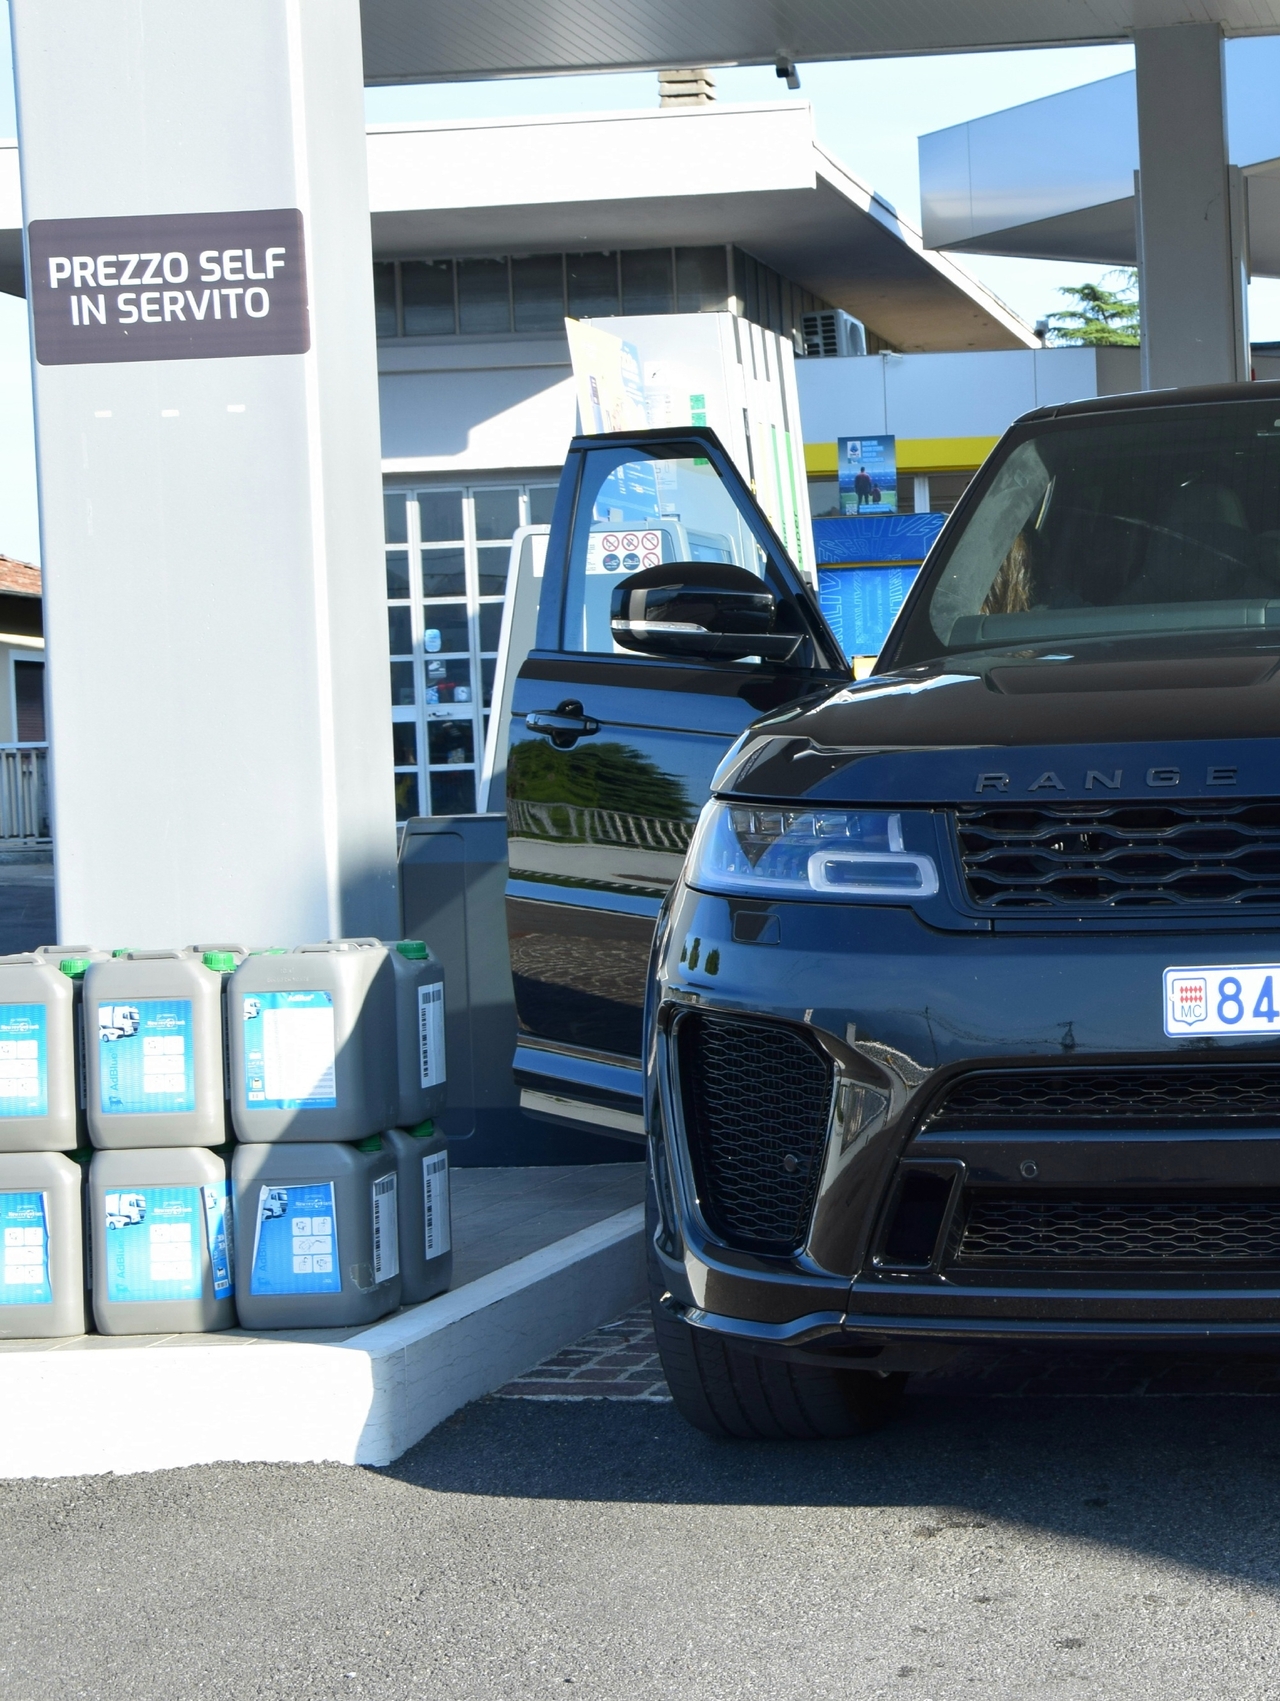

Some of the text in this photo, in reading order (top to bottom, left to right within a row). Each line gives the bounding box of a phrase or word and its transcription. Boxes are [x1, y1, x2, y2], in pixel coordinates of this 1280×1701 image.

[48, 247, 287, 289] PREZZO SELF
[70, 287, 270, 326] IN SERVITO
[793, 510, 803, 564] super
[974, 766, 1238, 794] RANGE
[1180, 1003, 1202, 1019] MC
